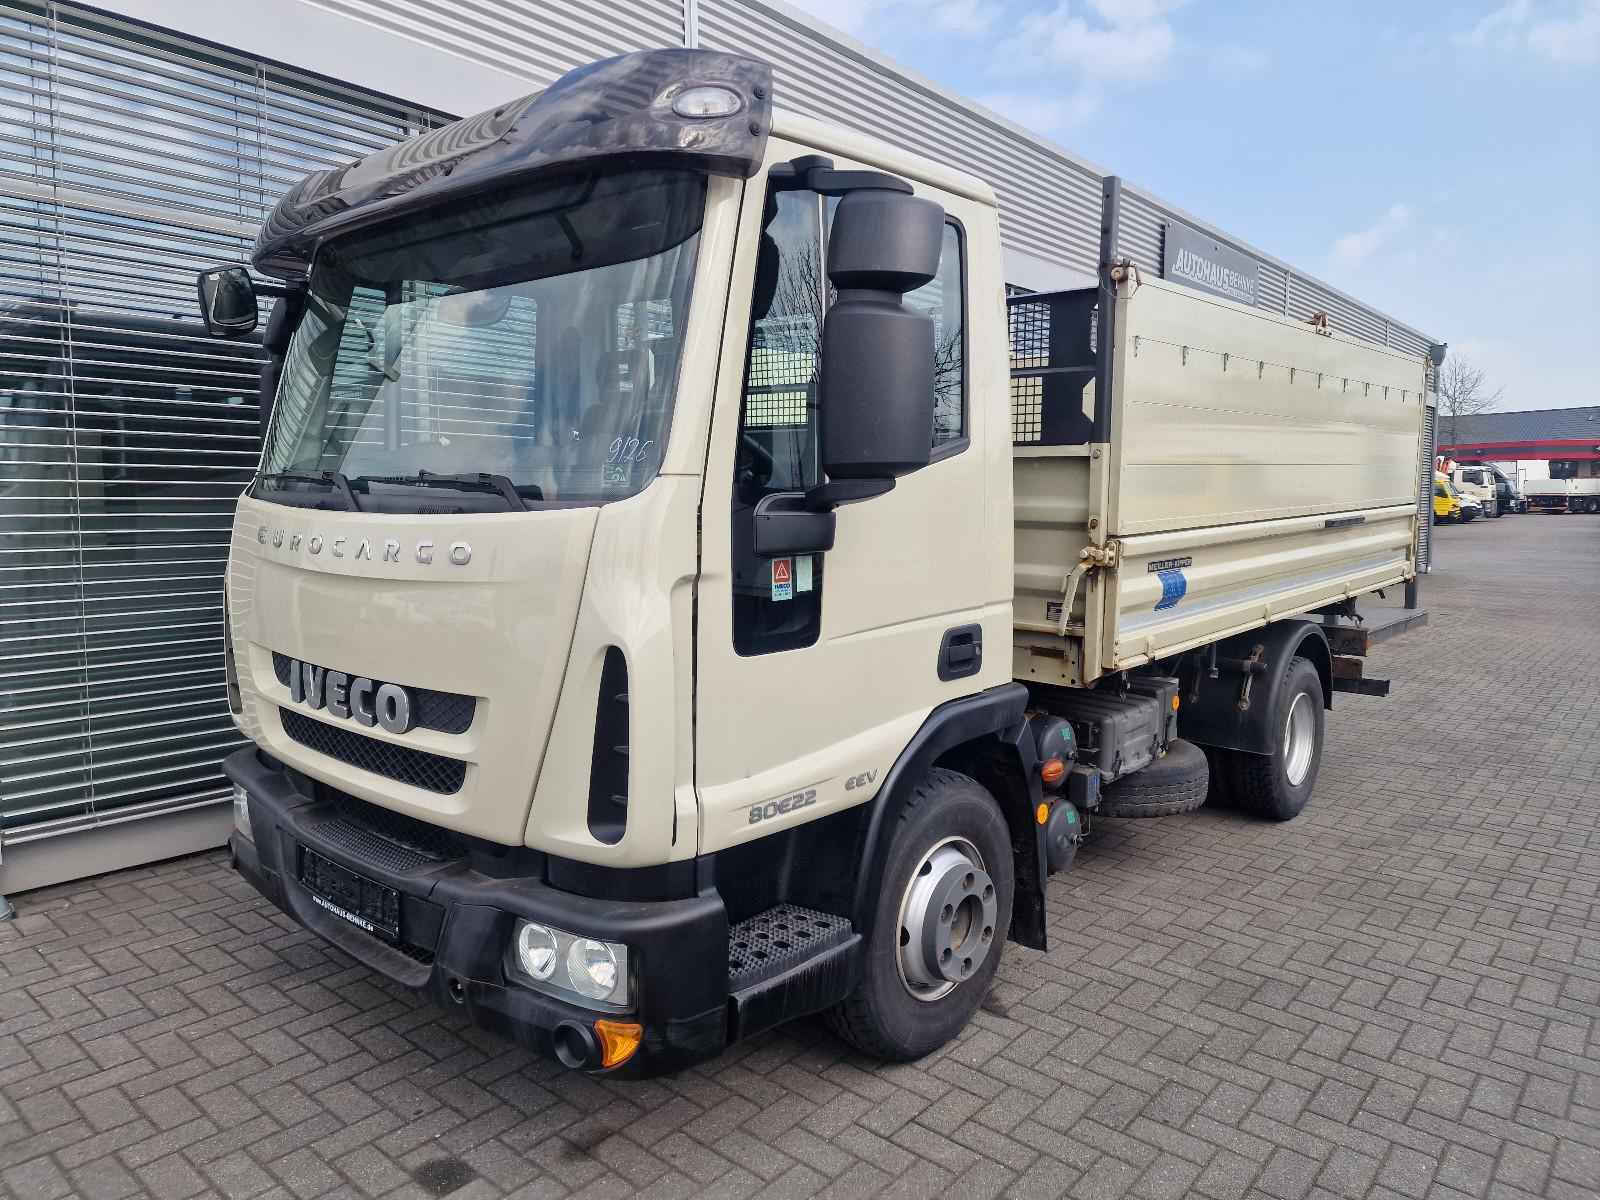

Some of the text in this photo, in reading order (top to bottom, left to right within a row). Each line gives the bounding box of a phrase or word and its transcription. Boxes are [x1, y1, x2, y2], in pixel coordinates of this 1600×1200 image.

[1171, 248, 1230, 290] AUTOHAUS
[257, 525, 472, 565] EUROCARGO
[290, 659, 412, 735] IVECO
[844, 768, 878, 791] EEV
[748, 789, 817, 825] 80E22
